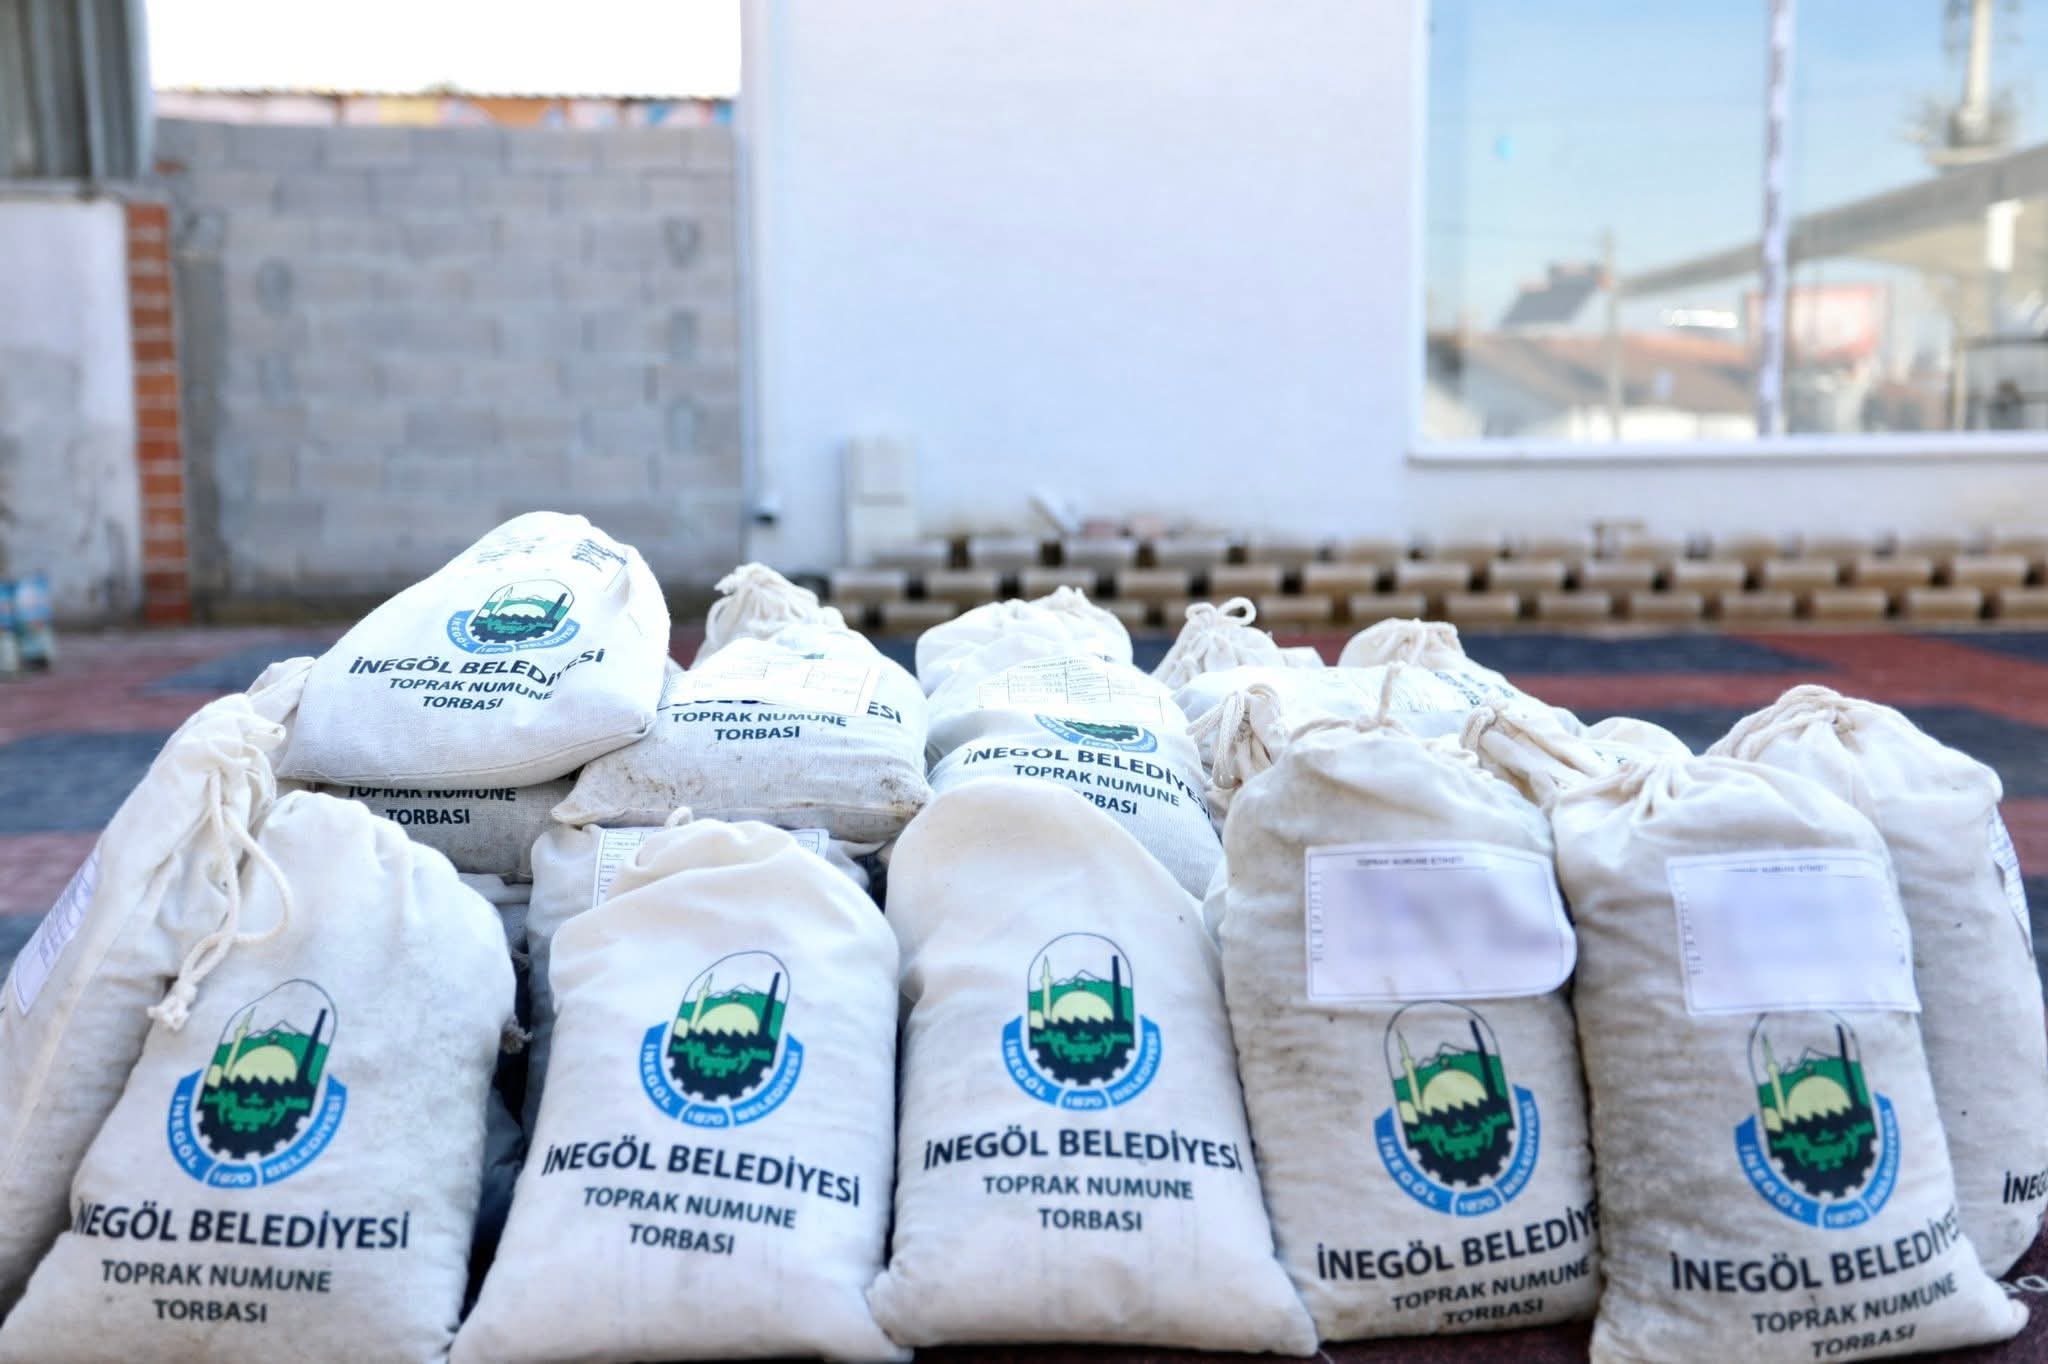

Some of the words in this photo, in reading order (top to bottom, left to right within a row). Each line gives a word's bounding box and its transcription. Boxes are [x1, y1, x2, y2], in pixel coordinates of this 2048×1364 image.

[348, 655, 453, 675] İNEGÖL
[388, 677, 464, 693] TOPRAK
[467, 681, 554, 702] NUMUNE
[422, 695, 504, 711] TORBASI
[672, 711, 753, 724] TOPRAK
[757, 712, 848, 728] NUMUNE
[714, 725, 801, 741] TORBASI
[1013, 764, 1092, 785] TOPRAK
[1096, 775, 1180, 808] NUMUNE
[385, 808, 471, 825] TORBASI
[642, 1043, 672, 1110] İNEGÖL
[1005, 1038, 1047, 1098] İNEGÖL
[170, 1094, 201, 1170] İNEGÖL
[265, 1094, 343, 1178] BELEDİYESİ
[923, 1125, 1049, 1171] İNEGÖL
[1058, 1128, 1244, 1173] BELEDİYESİ
[541, 1134, 657, 1176] İNEGÖL
[666, 1143, 861, 1208] BELEDİYESİ
[982, 1175, 1081, 1197] TOPRAK
[1086, 1176, 1196, 1200] NUMUNE
[1380, 1135, 1438, 1205] İNEGÖL
[582, 1186, 679, 1214] TOPRAK
[685, 1195, 798, 1230] NUMUNE
[1038, 1207, 1143, 1232] TORBASI
[188, 1209, 411, 1251] BELEDİYESİ
[628, 1222, 736, 1256] TORBASI
[100, 1259, 202, 1287] TOPRAK
[209, 1264, 333, 1294] NUMUNE
[1316, 1239, 1454, 1282] İNEGÖL
[1669, 1251, 1823, 1293] İNEGÖL
[1391, 1279, 1488, 1313] TOPRAK
[1490, 1255, 1591, 1297] NUMUNE
[1752, 1298, 1857, 1335] TOPRAK
[1863, 1271, 1959, 1322] NUMUNE
[154, 1299, 268, 1324] TORBASI
[1442, 1297, 1546, 1327] TORBASI
[1812, 1323, 1918, 1360] TORBASI
